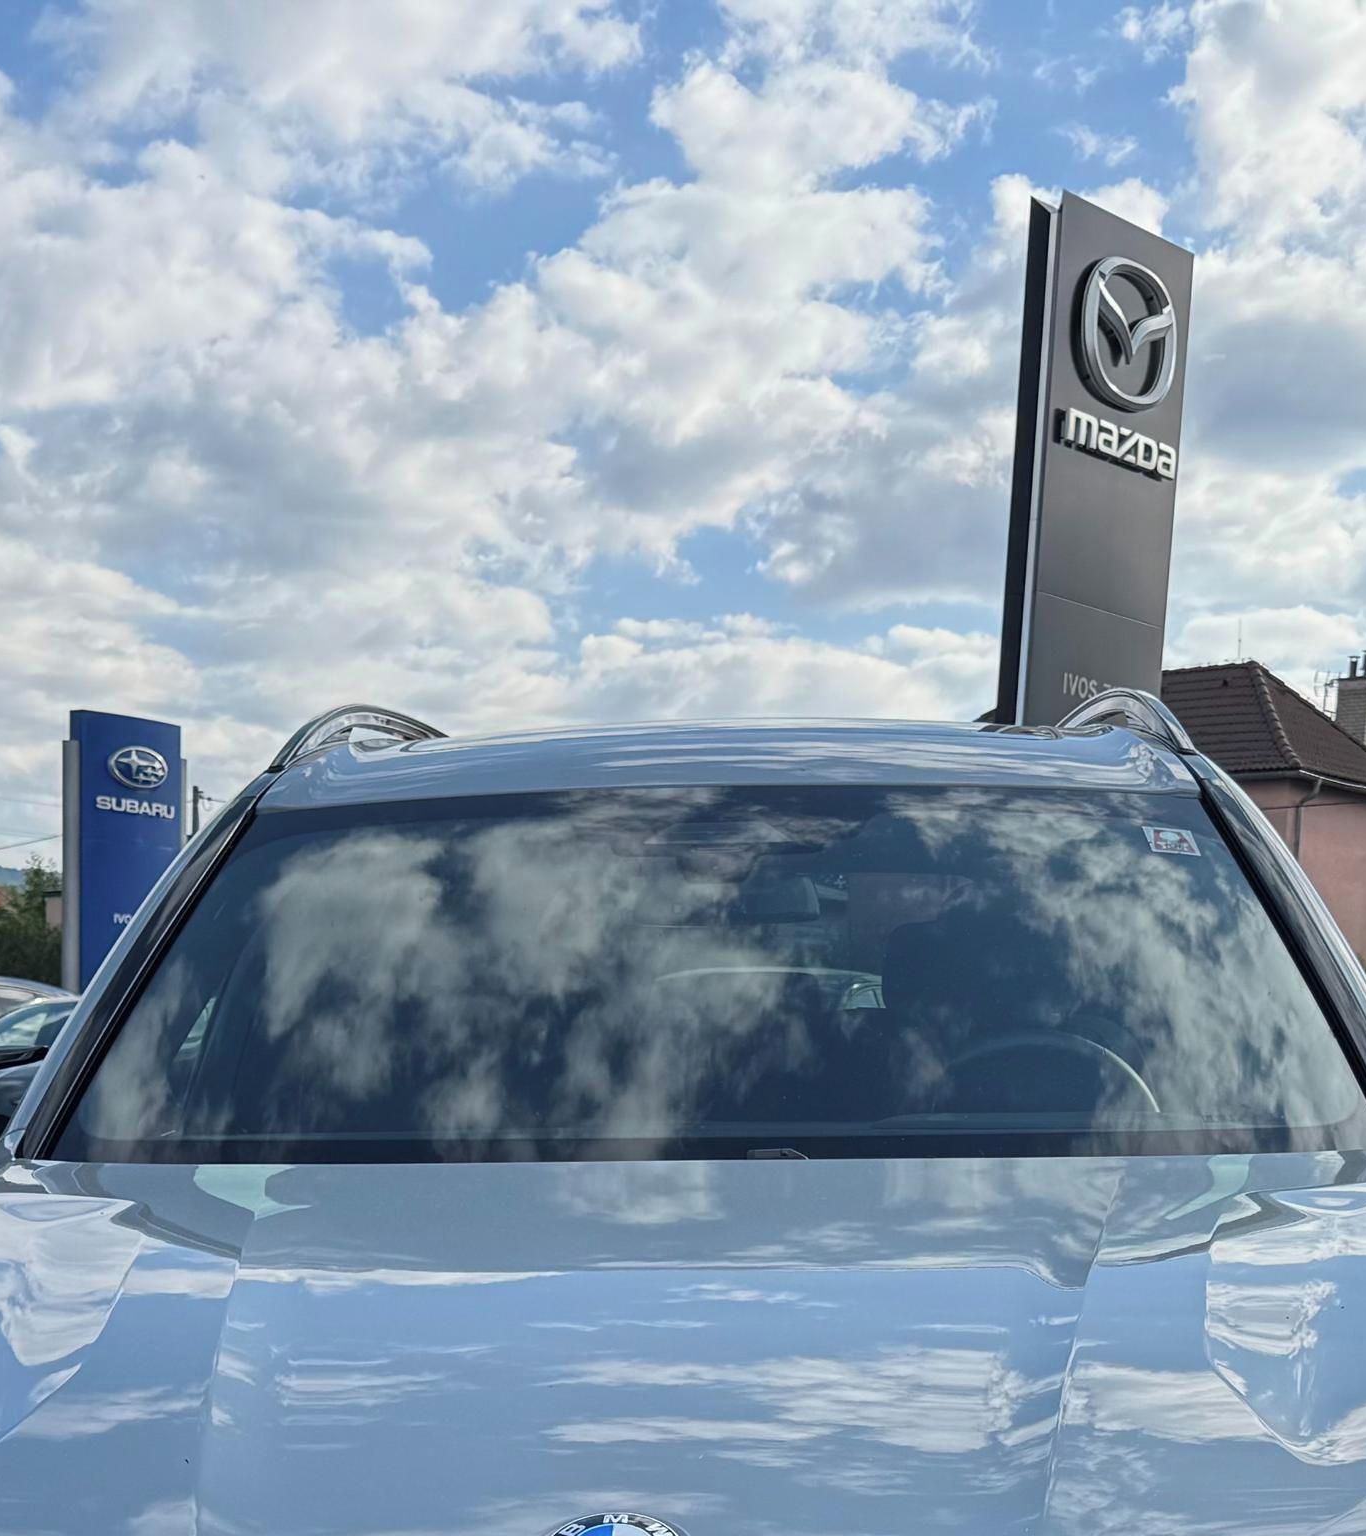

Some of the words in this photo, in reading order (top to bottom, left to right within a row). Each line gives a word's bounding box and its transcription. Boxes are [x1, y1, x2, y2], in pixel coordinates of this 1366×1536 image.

[1062, 672, 1098, 699] IVOS
[95, 795, 176, 819] SUBARU
[113, 912, 133, 924] IVO
